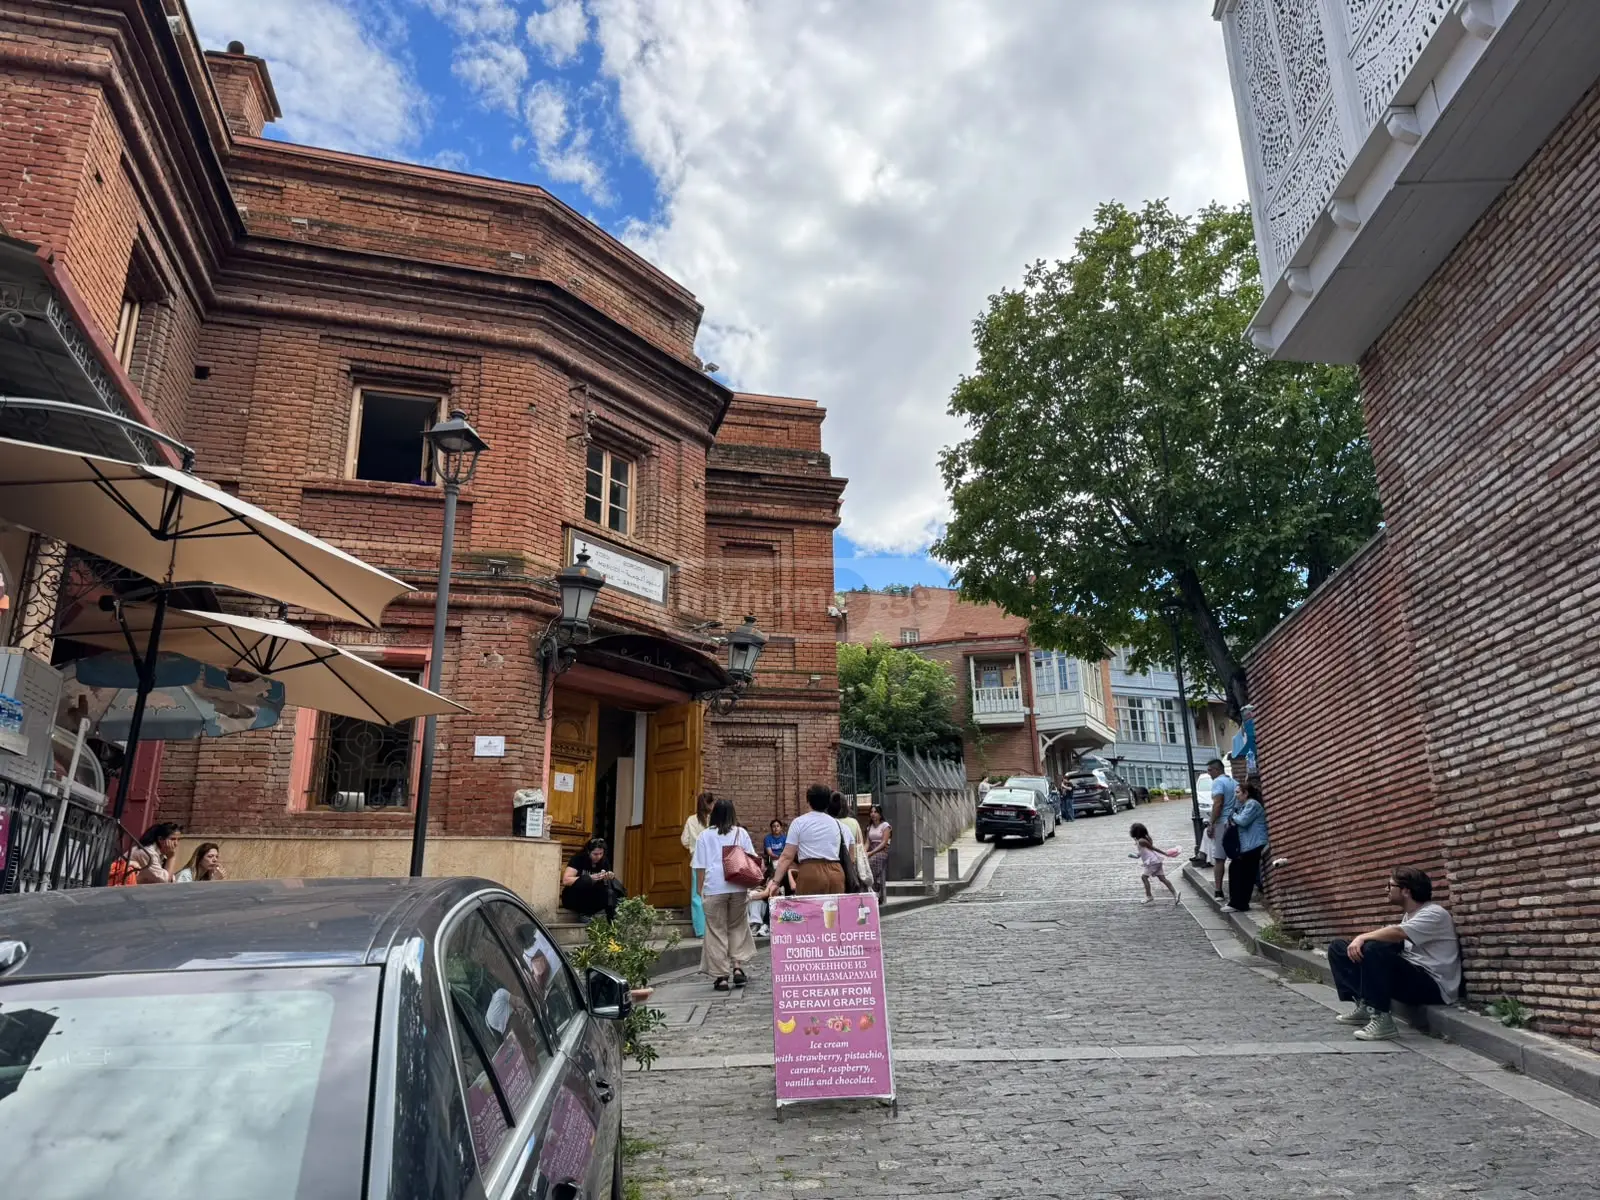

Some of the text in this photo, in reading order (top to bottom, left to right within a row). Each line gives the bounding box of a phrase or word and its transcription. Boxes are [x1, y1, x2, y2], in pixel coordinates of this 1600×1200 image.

[795, 933, 816, 944] ყავა
[821, 931, 877, 943] ICE COFFEE
[786, 944, 864, 959] ღვინის ნაყინი
[784, 960, 867, 972] МОРОЖЕННОЕ ИЗ
[775, 970, 877, 983] ВИНА КИНДЗМАРАУЛИ
[782, 986, 872, 999] ICE CREAM FROM
[778, 996, 876, 1009] SAPERAVI GRAPES
[810, 1040, 849, 1049] Ice cream
[775, 1050, 885, 1063] with strawberry, pistachio,
[790, 1063, 871, 1075] caramel, raspberry,
[785, 1075, 877, 1087] vanilla and chocolate.
